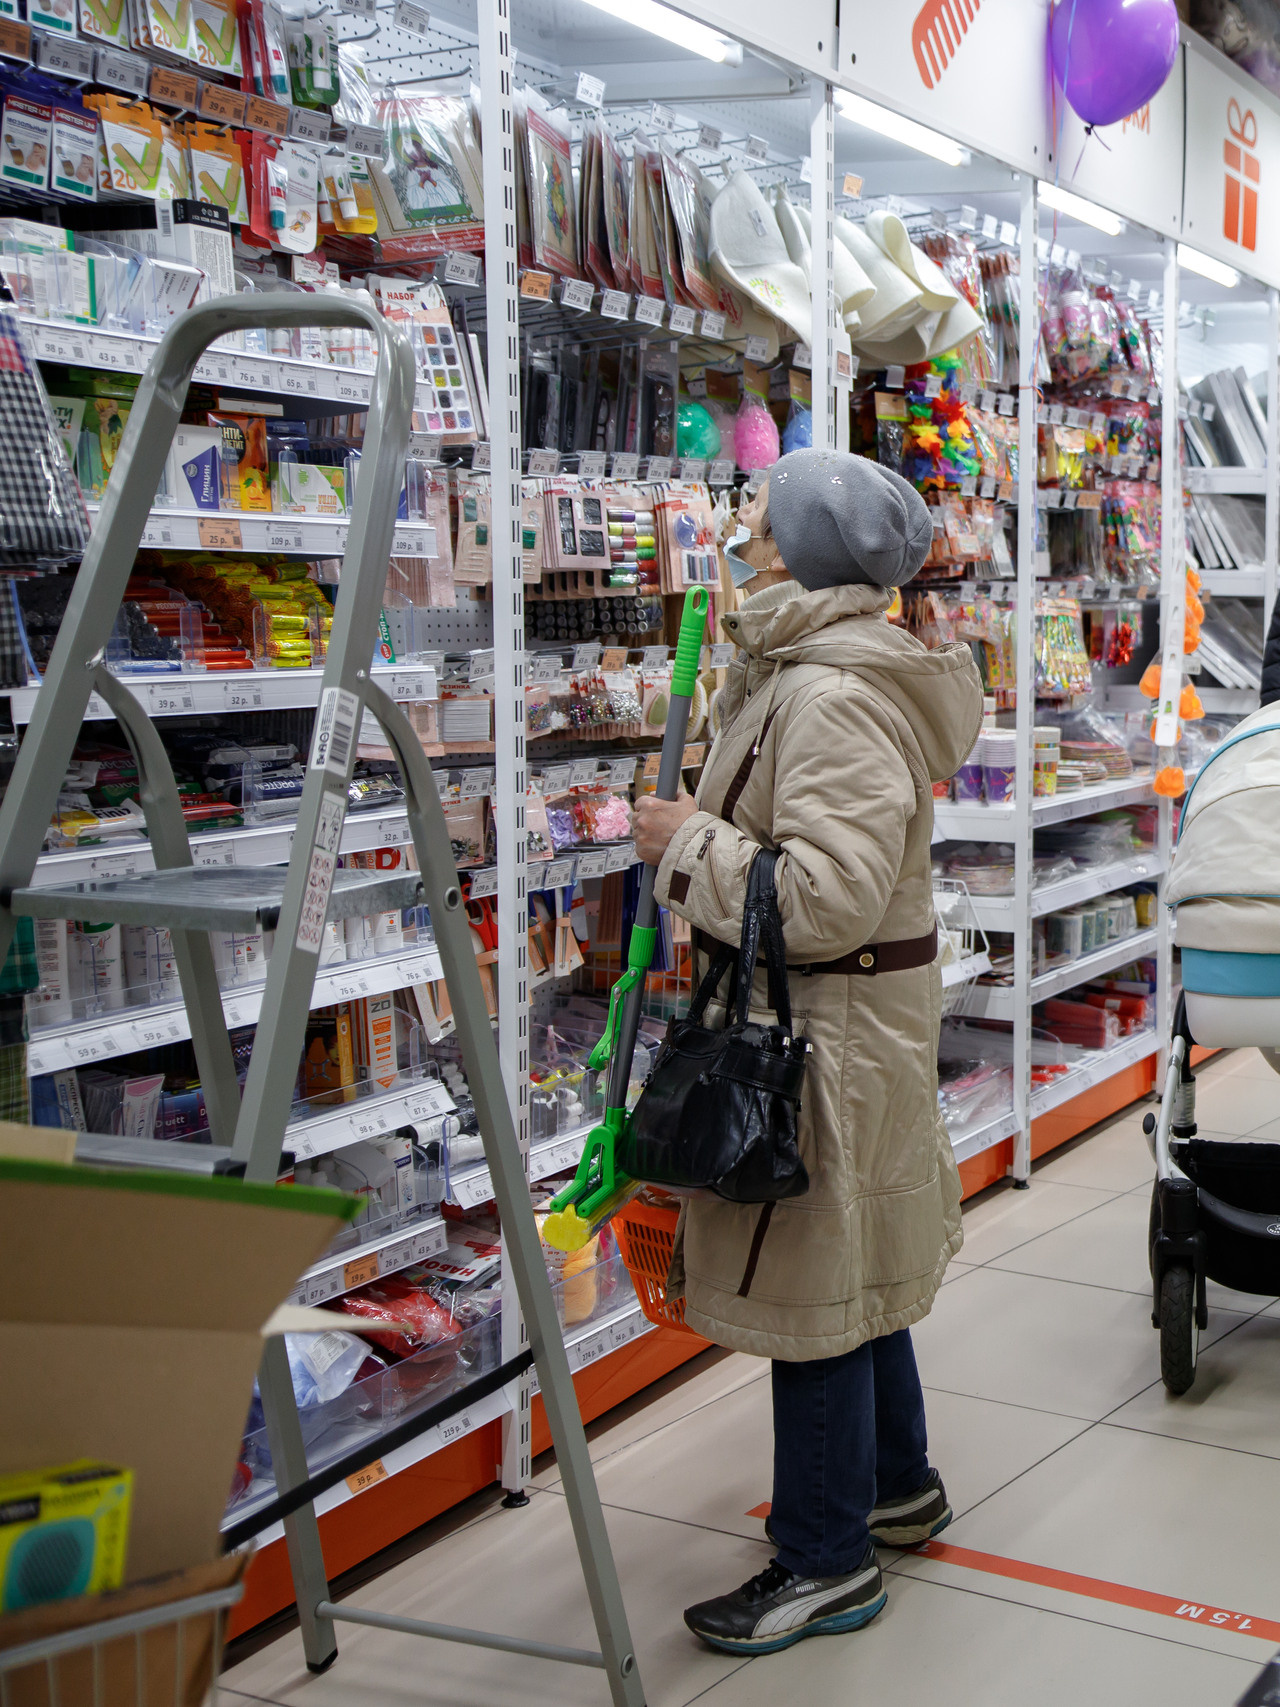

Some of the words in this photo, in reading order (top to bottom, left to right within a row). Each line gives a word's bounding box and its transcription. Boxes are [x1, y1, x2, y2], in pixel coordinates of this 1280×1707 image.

[387, 291, 414, 300] НАБОР
[218, 426, 243, 439] НТИ-
[201, 465, 211, 502] Глицин
[1209, 1612, 1252, 1630] 1,5
